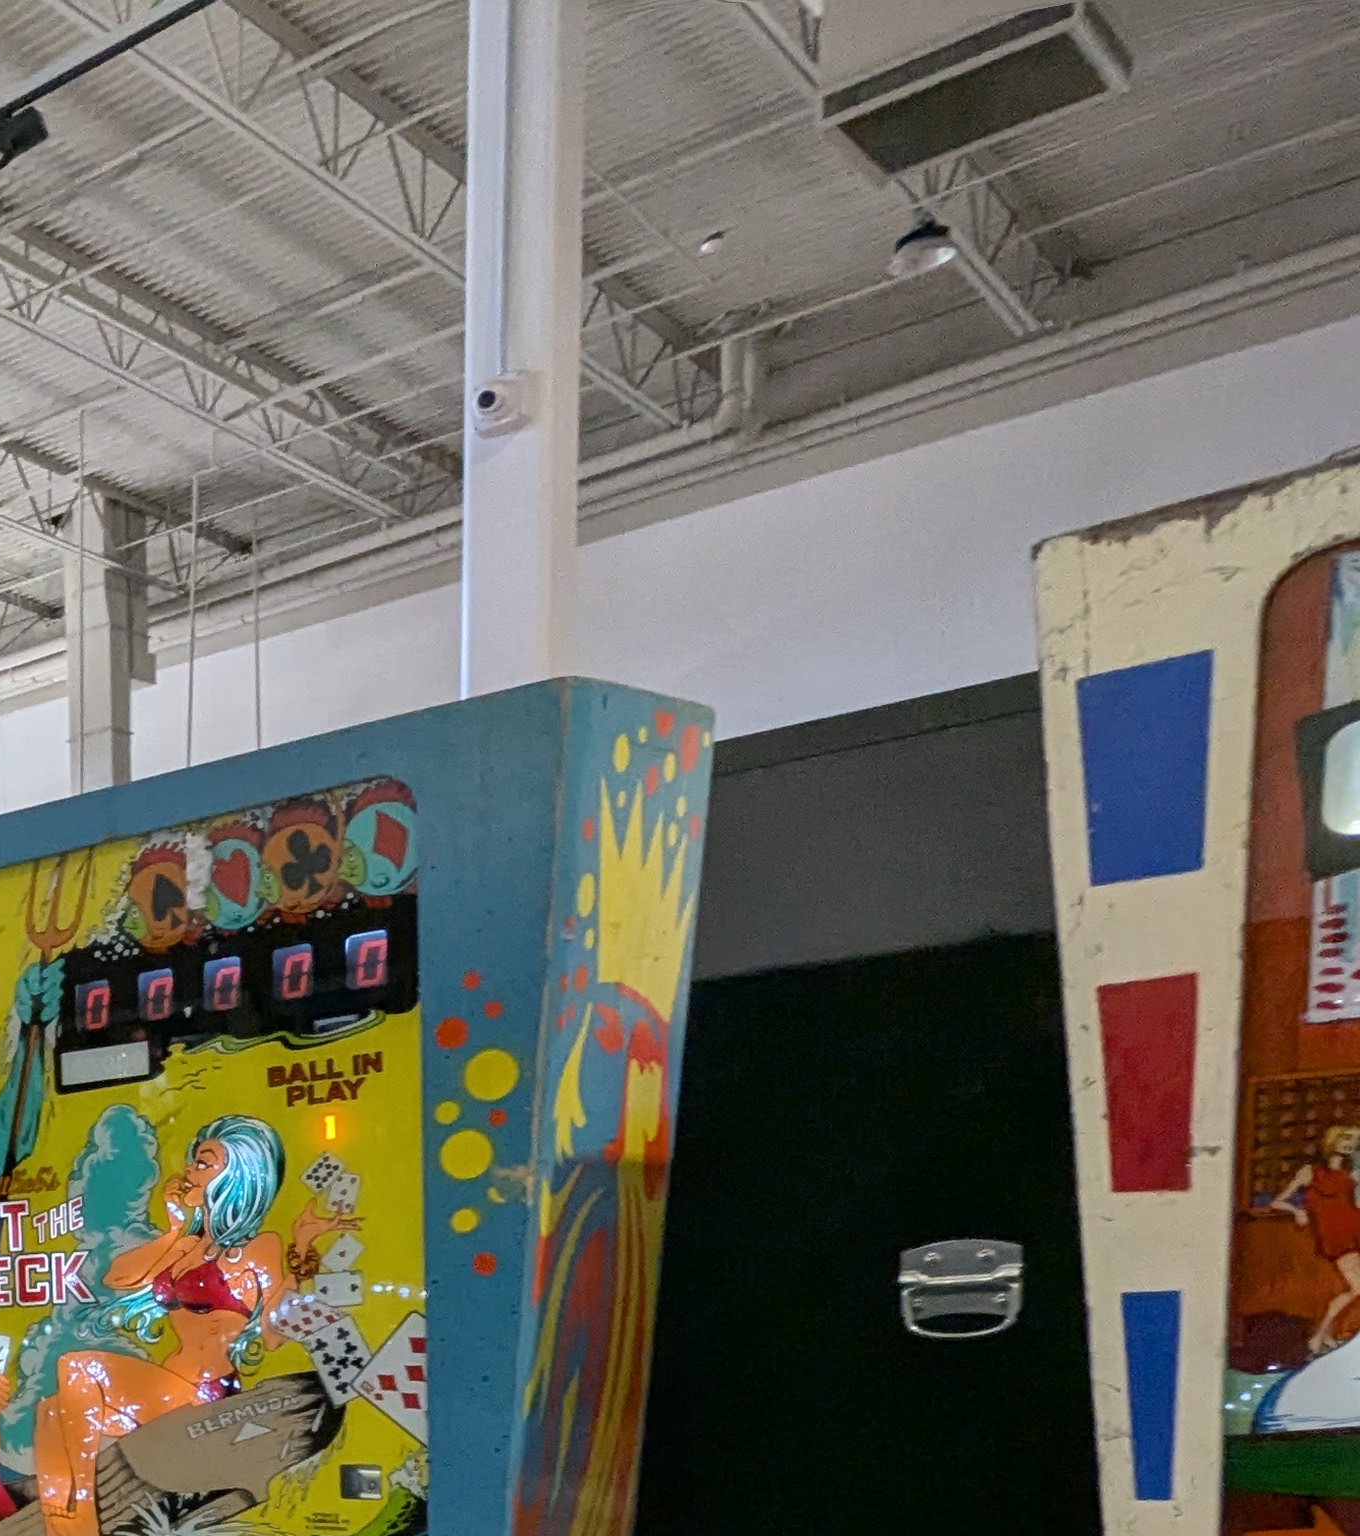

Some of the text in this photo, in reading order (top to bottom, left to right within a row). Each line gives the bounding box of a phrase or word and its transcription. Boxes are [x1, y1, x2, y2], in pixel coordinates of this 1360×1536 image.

[267, 1052, 383, 1088] BALL IN
[286, 1077, 368, 1107] PLAY
[324, 1115, 336, 1140] 1
[33, 1196, 84, 1244] THE
